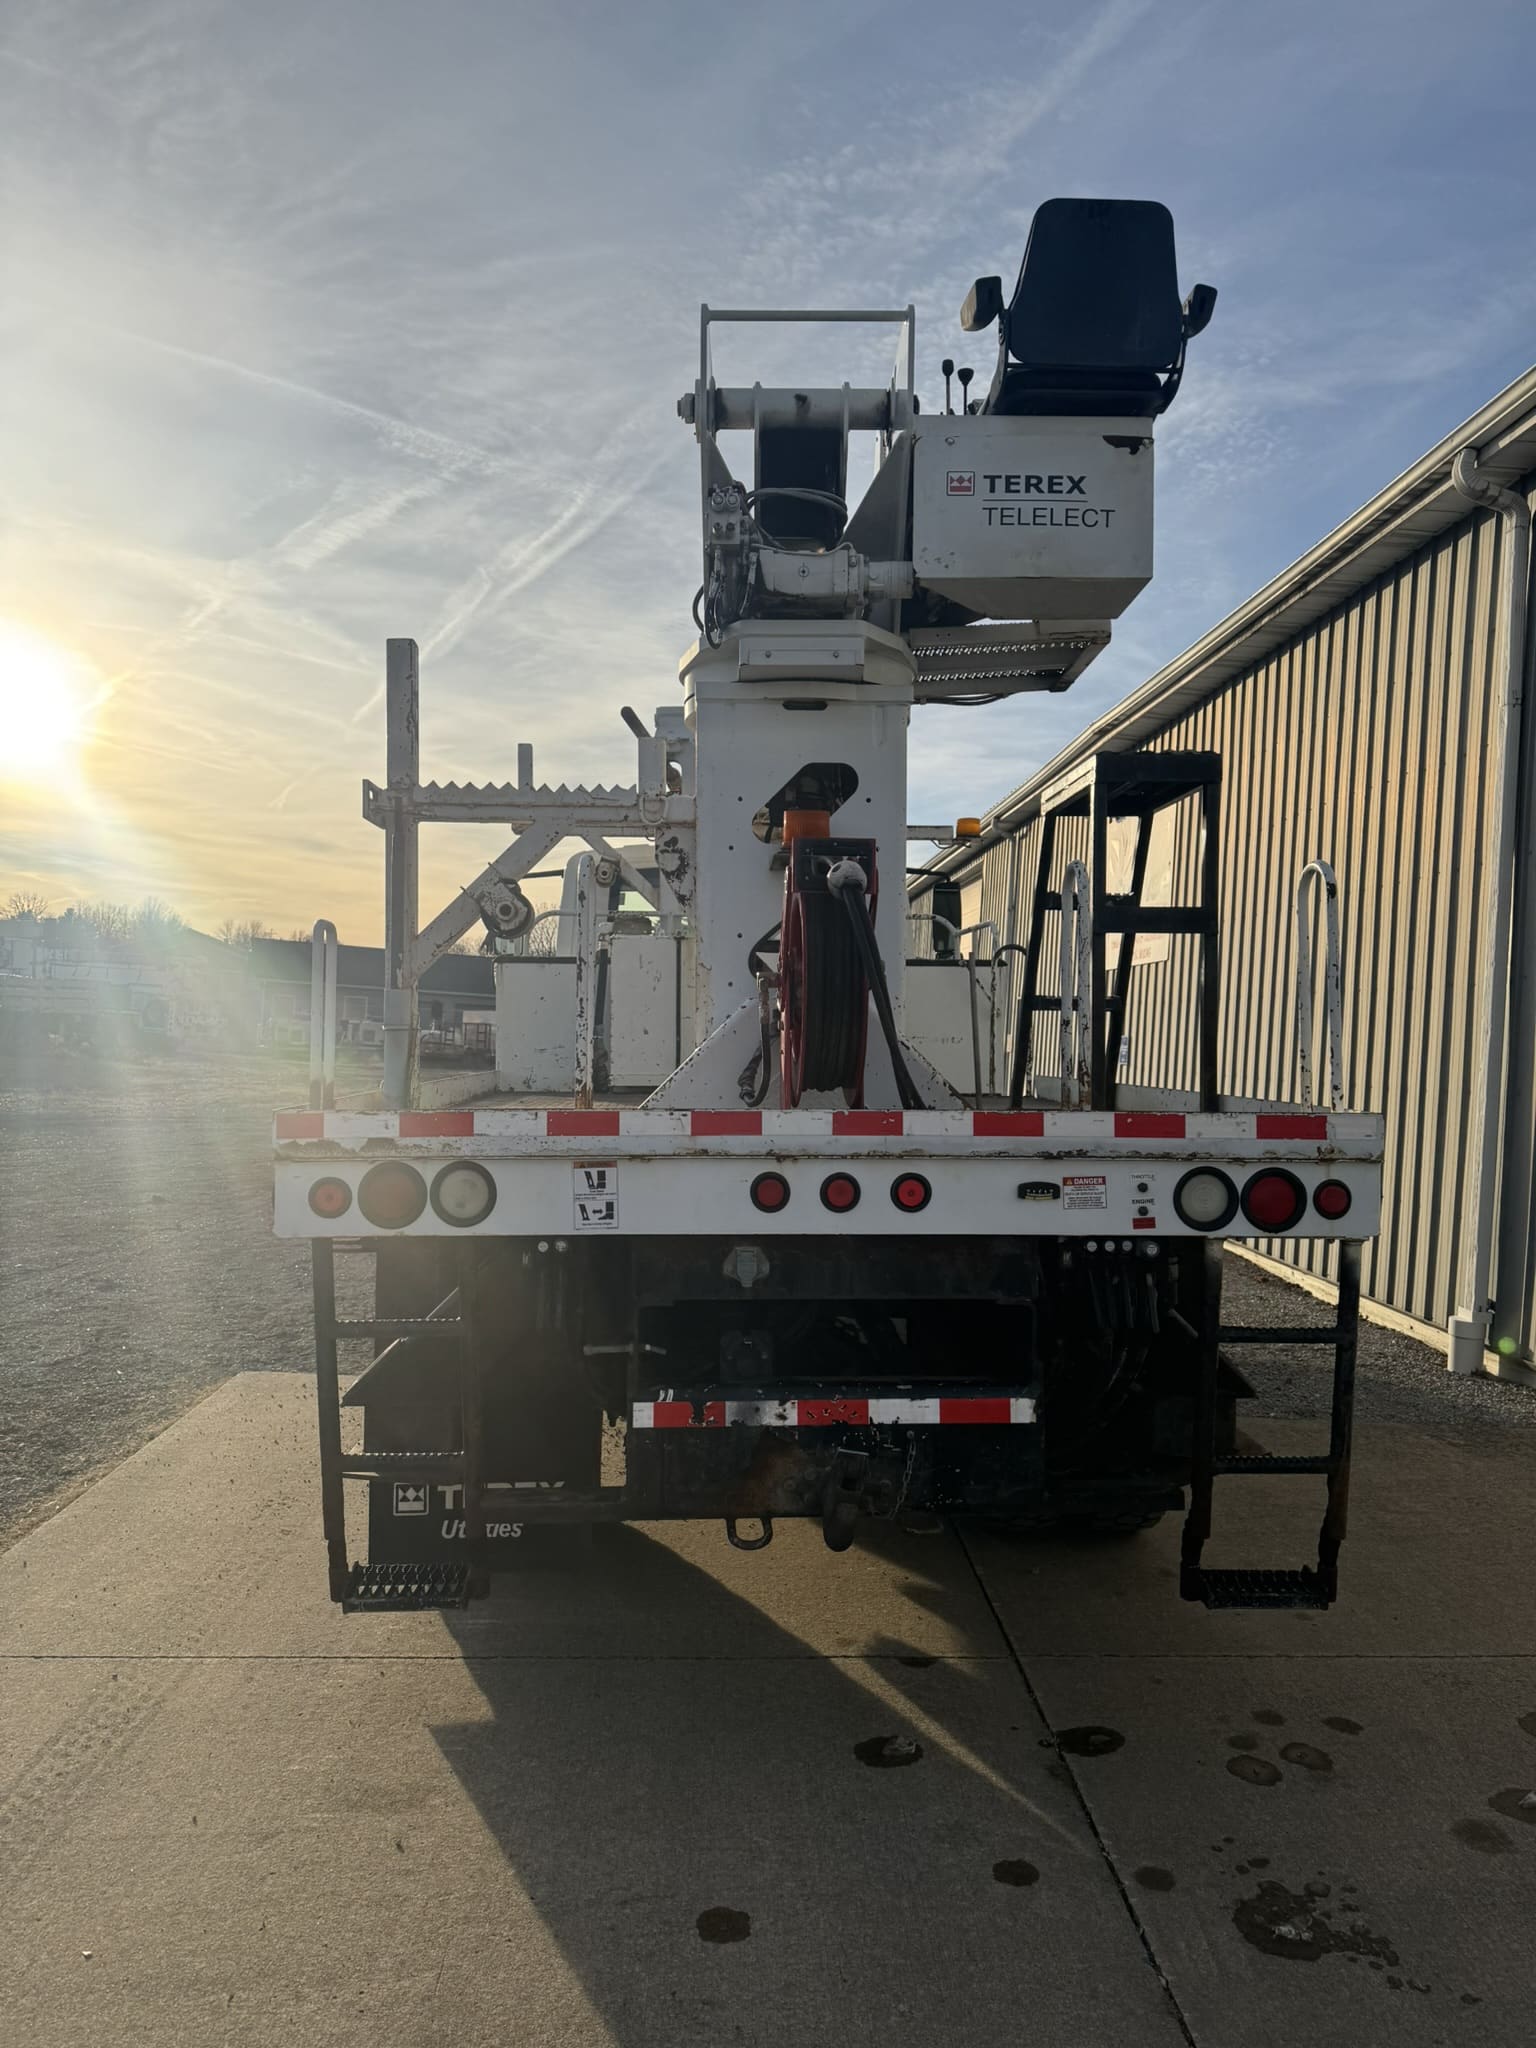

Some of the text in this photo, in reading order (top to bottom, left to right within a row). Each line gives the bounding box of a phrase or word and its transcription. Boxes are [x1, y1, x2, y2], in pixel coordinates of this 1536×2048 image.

[983, 474, 1088, 495] TEREX
[982, 507, 1116, 529] TELELECT
[1073, 1177, 1103, 1185] DANGER
[440, 1519, 524, 1539] Utties
